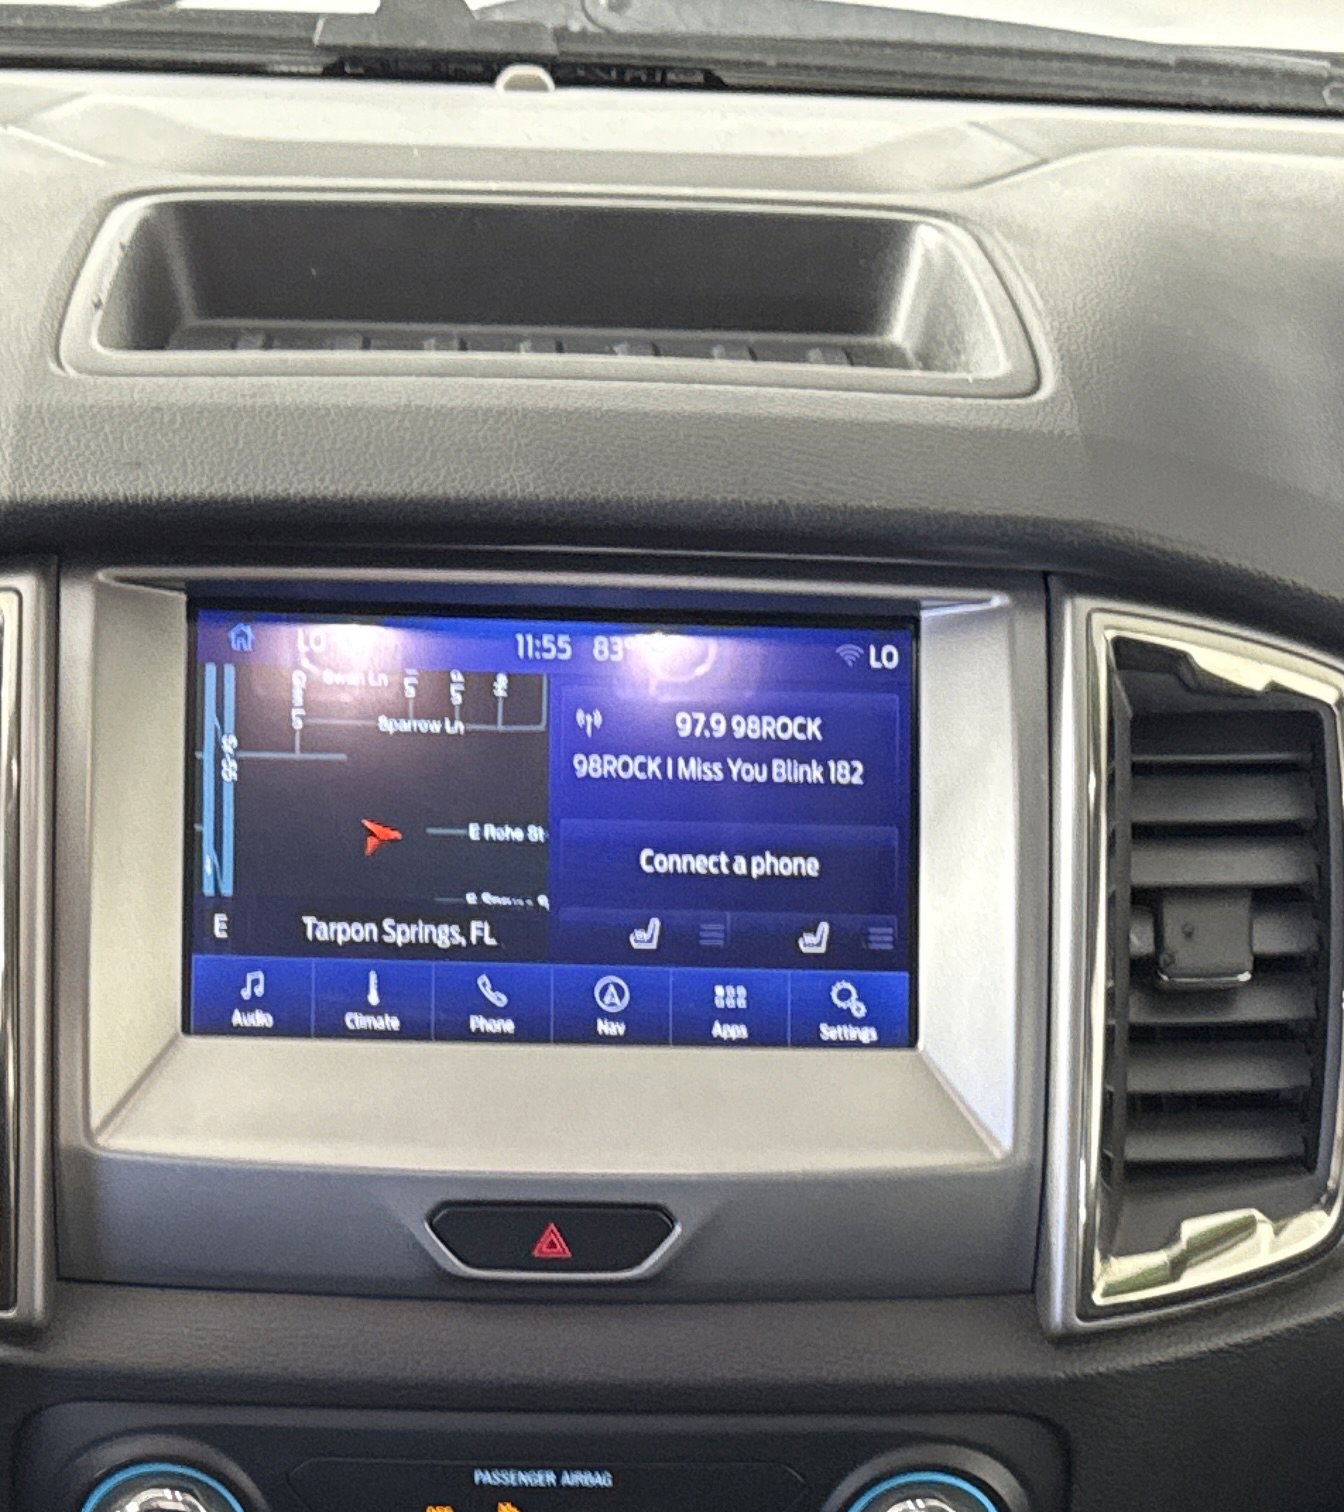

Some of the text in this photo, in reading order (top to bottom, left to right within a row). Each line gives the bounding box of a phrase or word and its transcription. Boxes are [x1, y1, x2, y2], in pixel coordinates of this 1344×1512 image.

[515, 632, 573, 662] 11:55
[869, 645, 900, 670] LO
[377, 714, 465, 736] Sparrow Ln
[675, 711, 823, 741] 97.9 98ROCK
[572, 753, 663, 780] 98ROCK
[677, 756, 724, 782] Miss
[727, 757, 768, 783] You
[771, 758, 825, 784] Blink
[827, 759, 864, 785] 182
[468, 822, 481, 841] E
[639, 848, 820, 879] Connect a phone
[213, 912, 229, 938] E
[302, 915, 499, 949] Tarpon Springs, FL
[231, 1008, 275, 1029] Audio
[344, 1011, 401, 1032] Climate
[469, 1014, 515, 1035] Phone
[596, 1017, 627, 1037] Nav
[711, 1020, 749, 1041] Apps
[819, 1023, 879, 1044] Settings
[473, 1468, 613, 1488] PASSENGER AIRBAG
